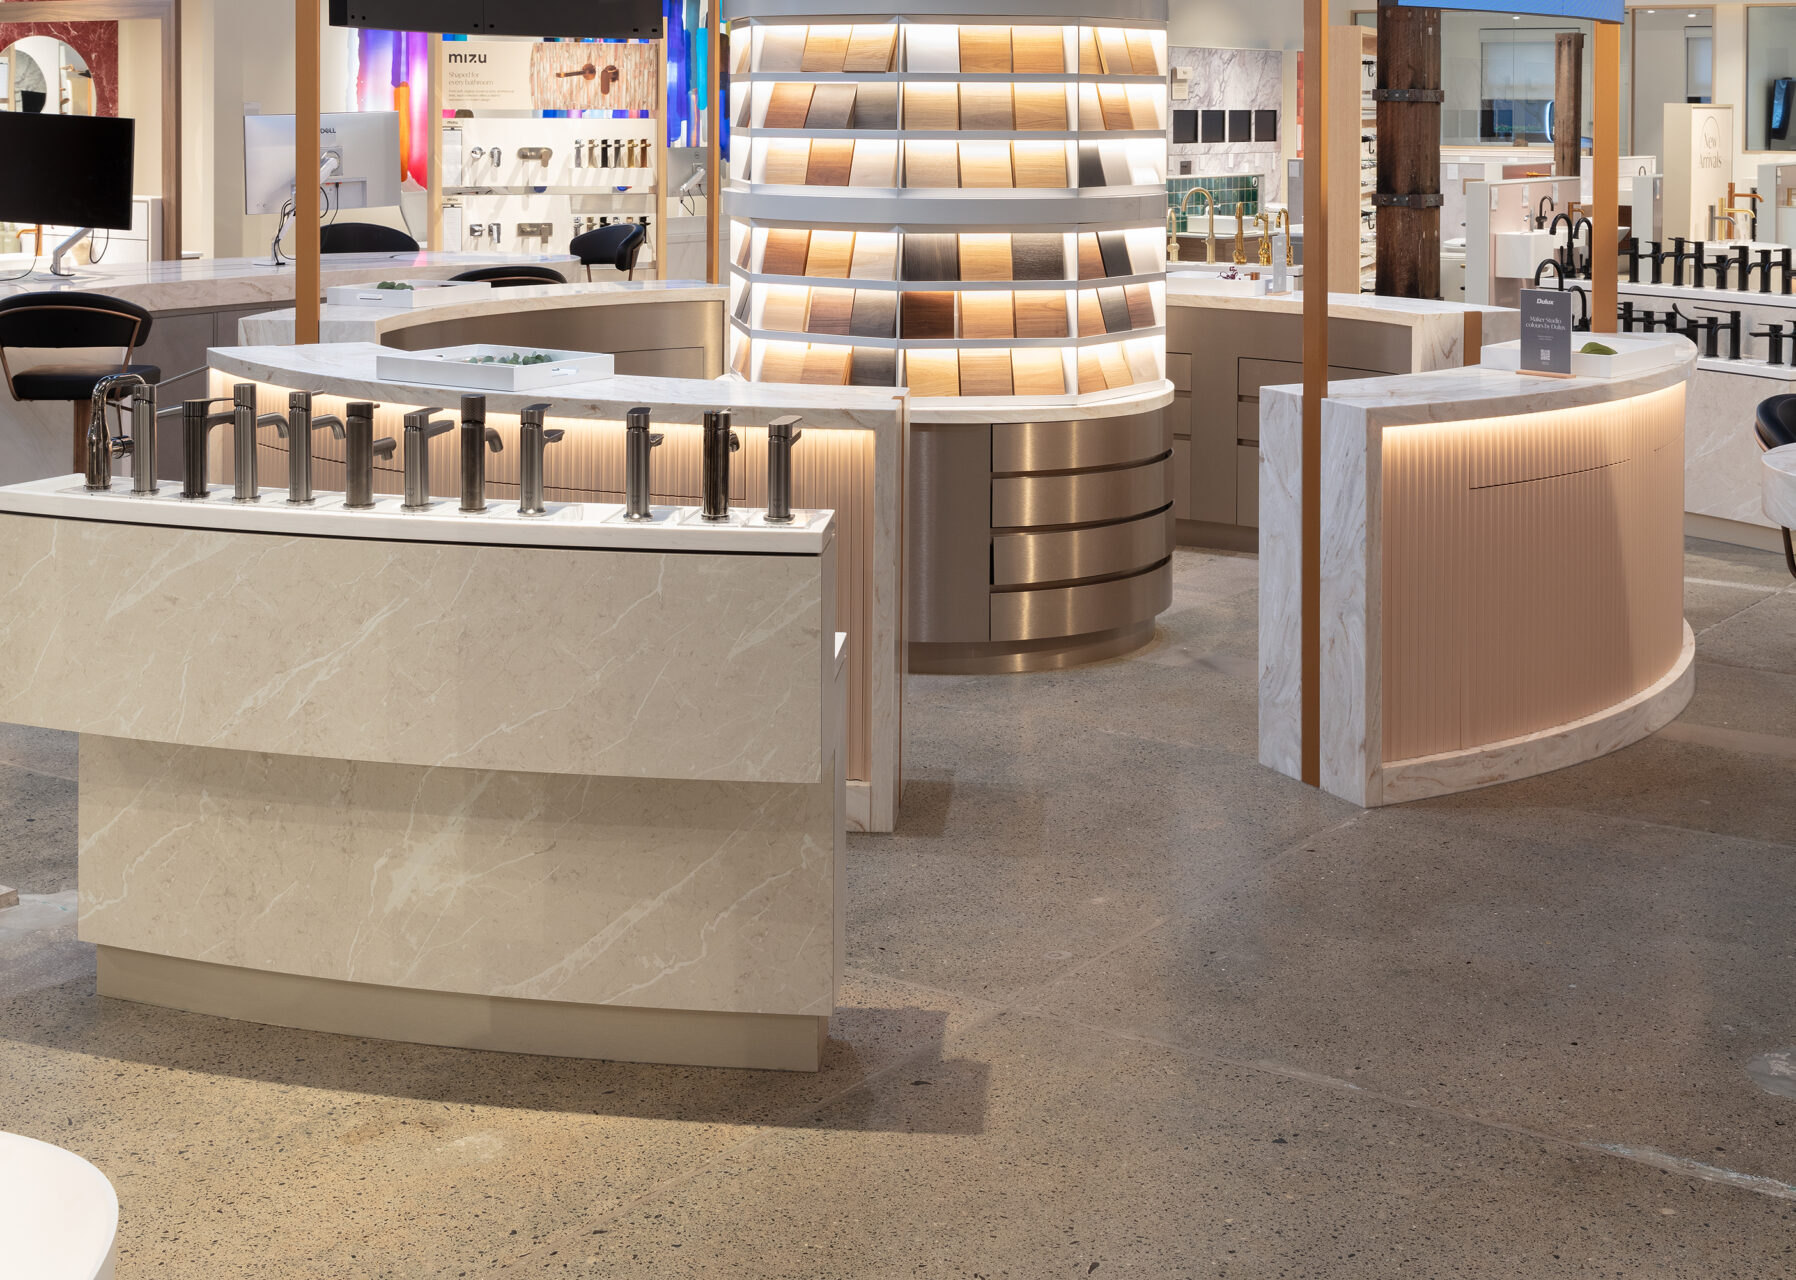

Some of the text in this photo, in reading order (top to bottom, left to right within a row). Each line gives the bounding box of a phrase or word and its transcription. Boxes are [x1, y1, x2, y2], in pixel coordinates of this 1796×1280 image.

[448, 53, 487, 64] mizu
[1704, 131, 1717, 149] New
[1699, 151, 1722, 169] Arrivals
[1536, 298, 1554, 306] Dulux
[1529, 315, 1545, 323] Maker
